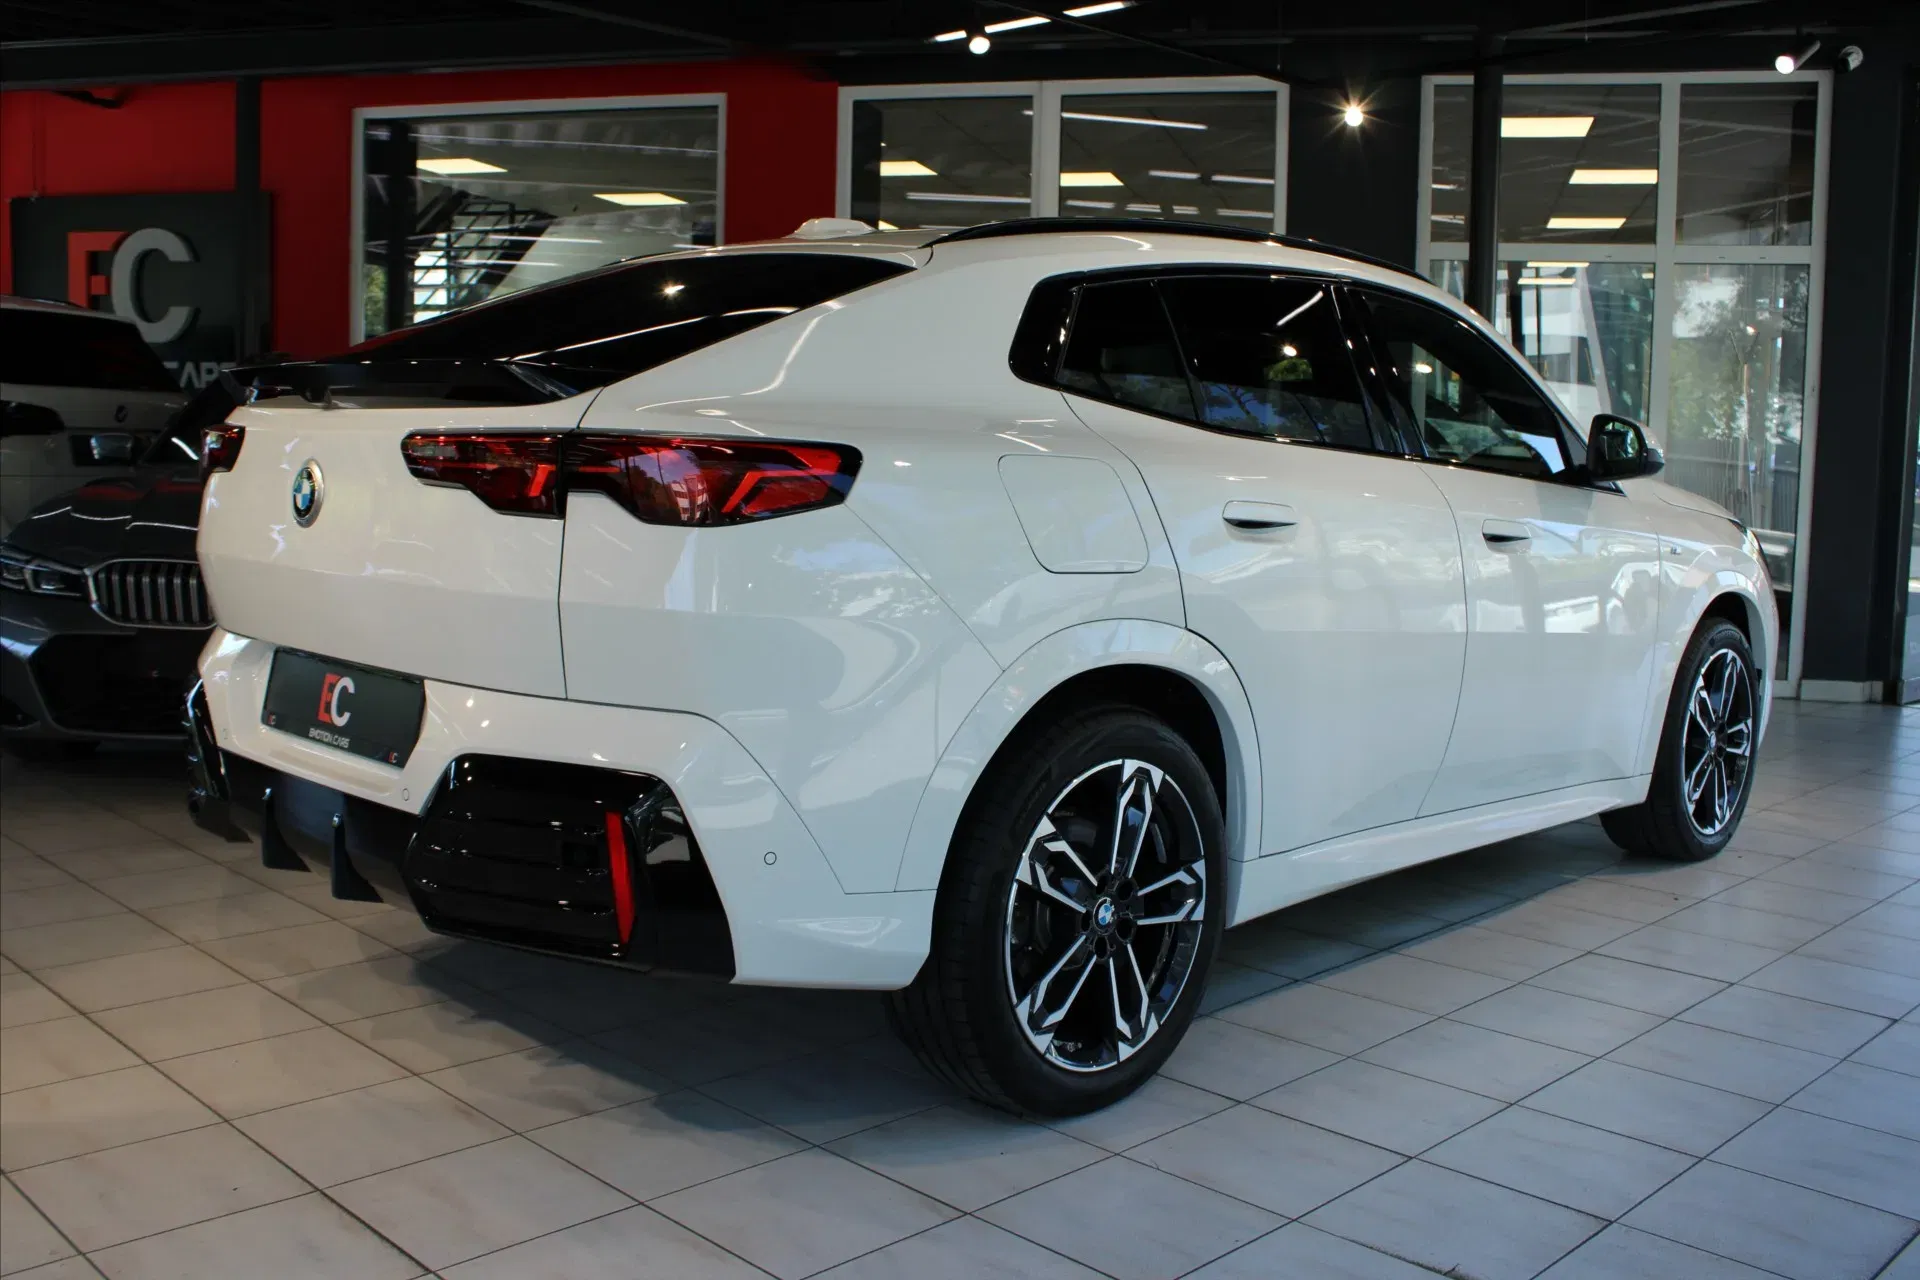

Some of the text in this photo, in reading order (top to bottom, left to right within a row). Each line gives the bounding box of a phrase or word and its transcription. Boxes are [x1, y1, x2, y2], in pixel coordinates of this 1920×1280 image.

[162, 361, 237, 389] AR
[318, 673, 355, 726] EC
[309, 728, 350, 748] EMOTION CARS
